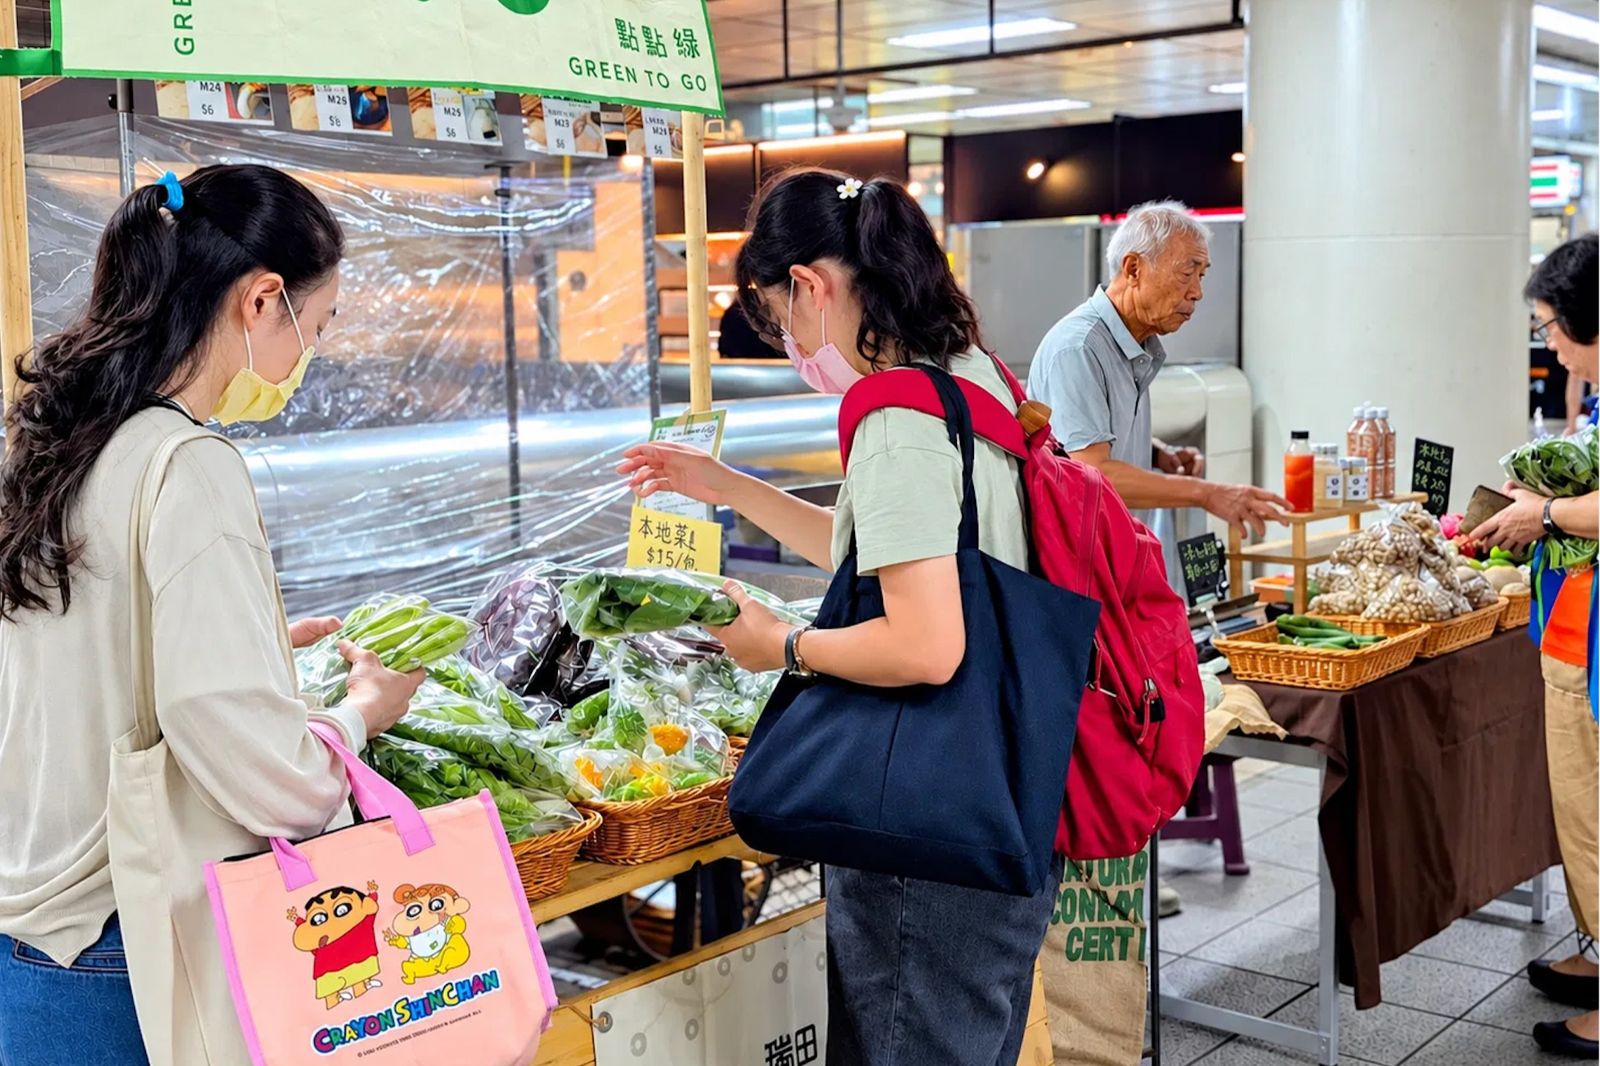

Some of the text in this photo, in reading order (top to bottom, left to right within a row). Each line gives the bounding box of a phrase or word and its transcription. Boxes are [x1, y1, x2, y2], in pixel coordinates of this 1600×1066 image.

[200, 82, 221, 92] M24
[568, 56, 707, 92] GREEN TO GO
[314, 1009, 395, 1053] CRAYON
[395, 969, 500, 1026] SHINCHAN
